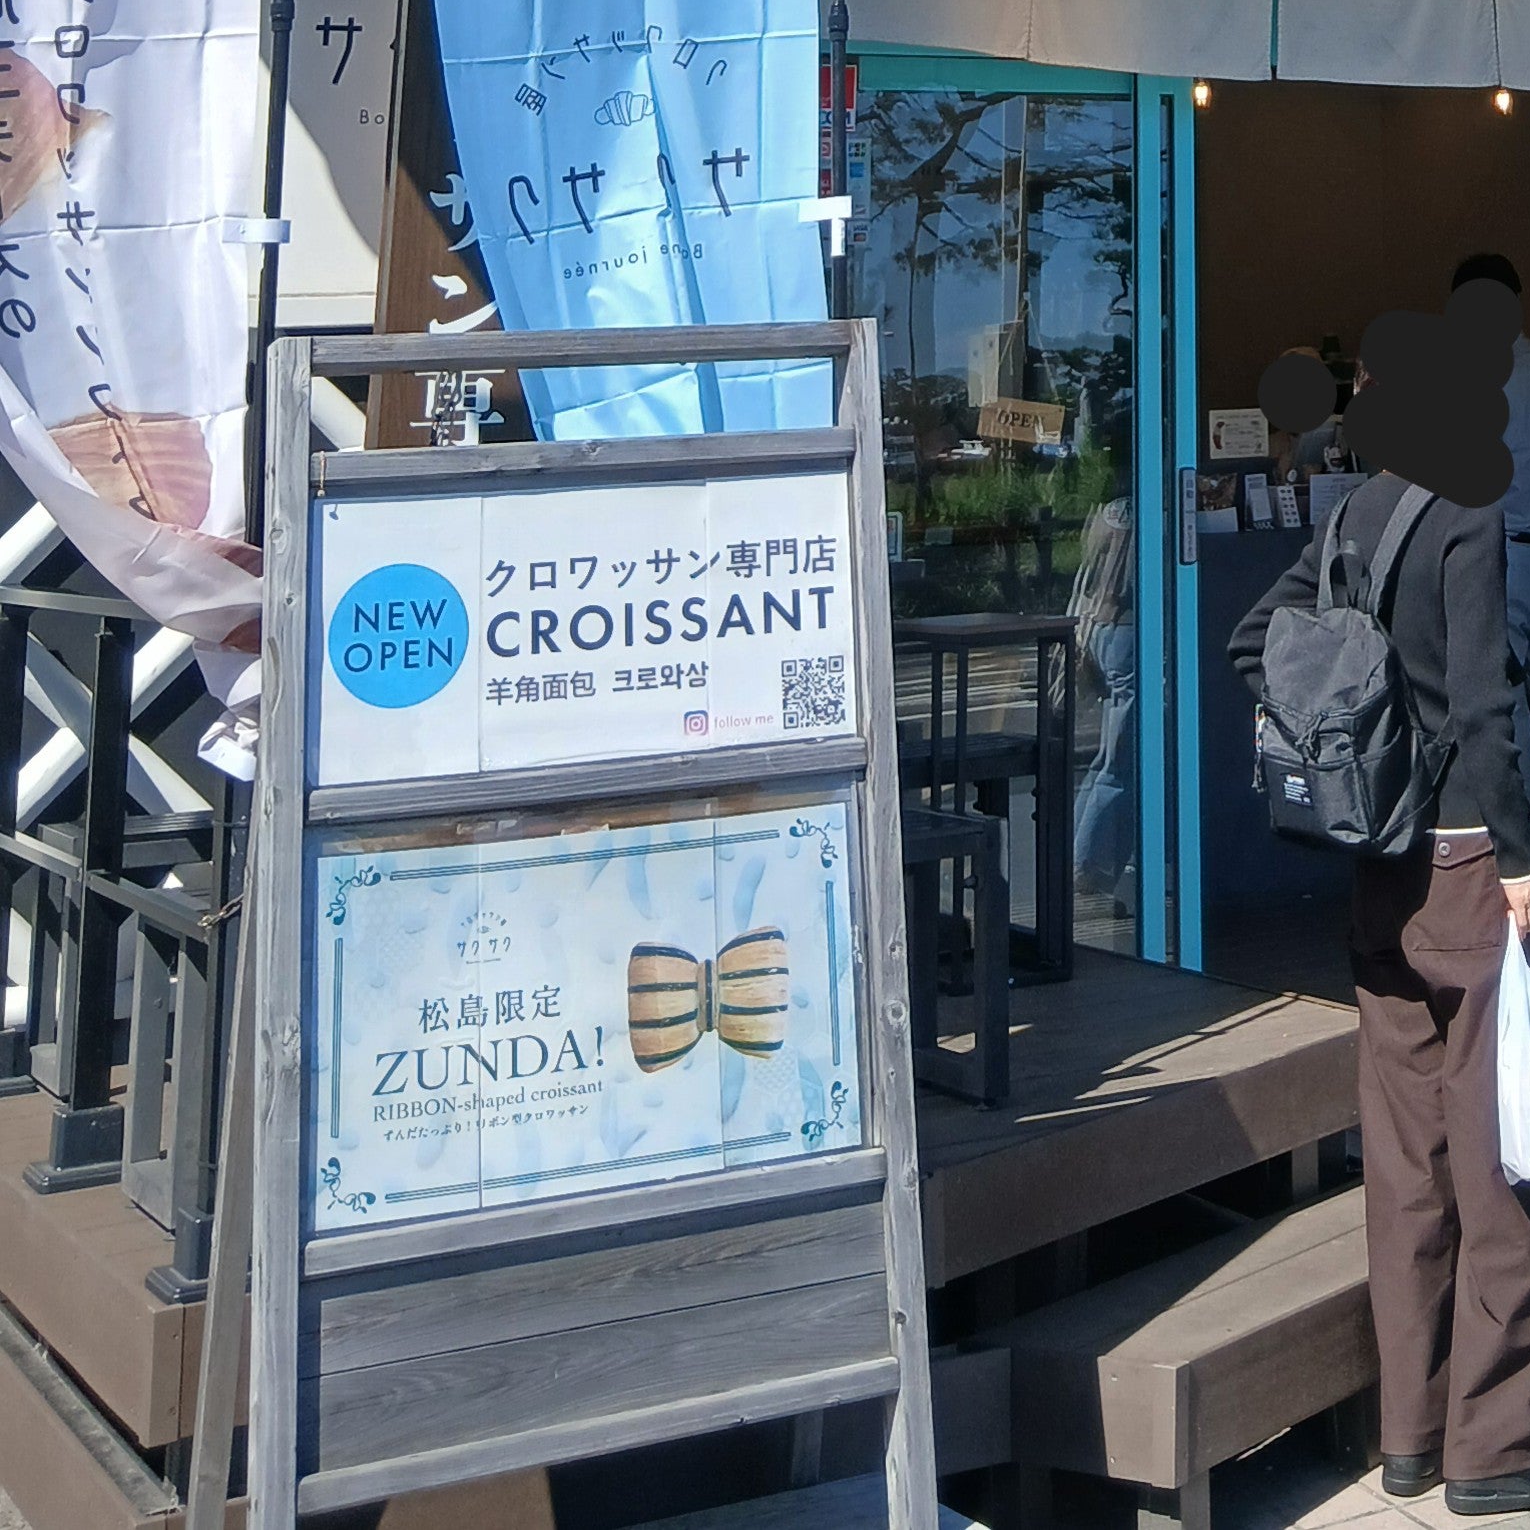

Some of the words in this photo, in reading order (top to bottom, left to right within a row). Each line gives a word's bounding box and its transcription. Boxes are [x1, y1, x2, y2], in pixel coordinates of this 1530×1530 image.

[998, 410, 1045, 429] OPEN
[485, 533, 838, 598] クロワッサン専門店
[353, 597, 448, 635] NEW
[485, 585, 836, 659] CROISSANT
[343, 635, 454, 673] OPEN
[485, 670, 597, 706] 羊角面包
[611, 661, 710, 696] 크로와상
[713, 714, 752, 730] follow
[755, 714, 774, 726] me
[418, 983, 562, 1033] 松島限定
[372, 1025, 605, 1098] ZUNDA!
[372, 1086, 525, 1123] RIBBON-shaped
[531, 1079, 603, 1102] croissant
